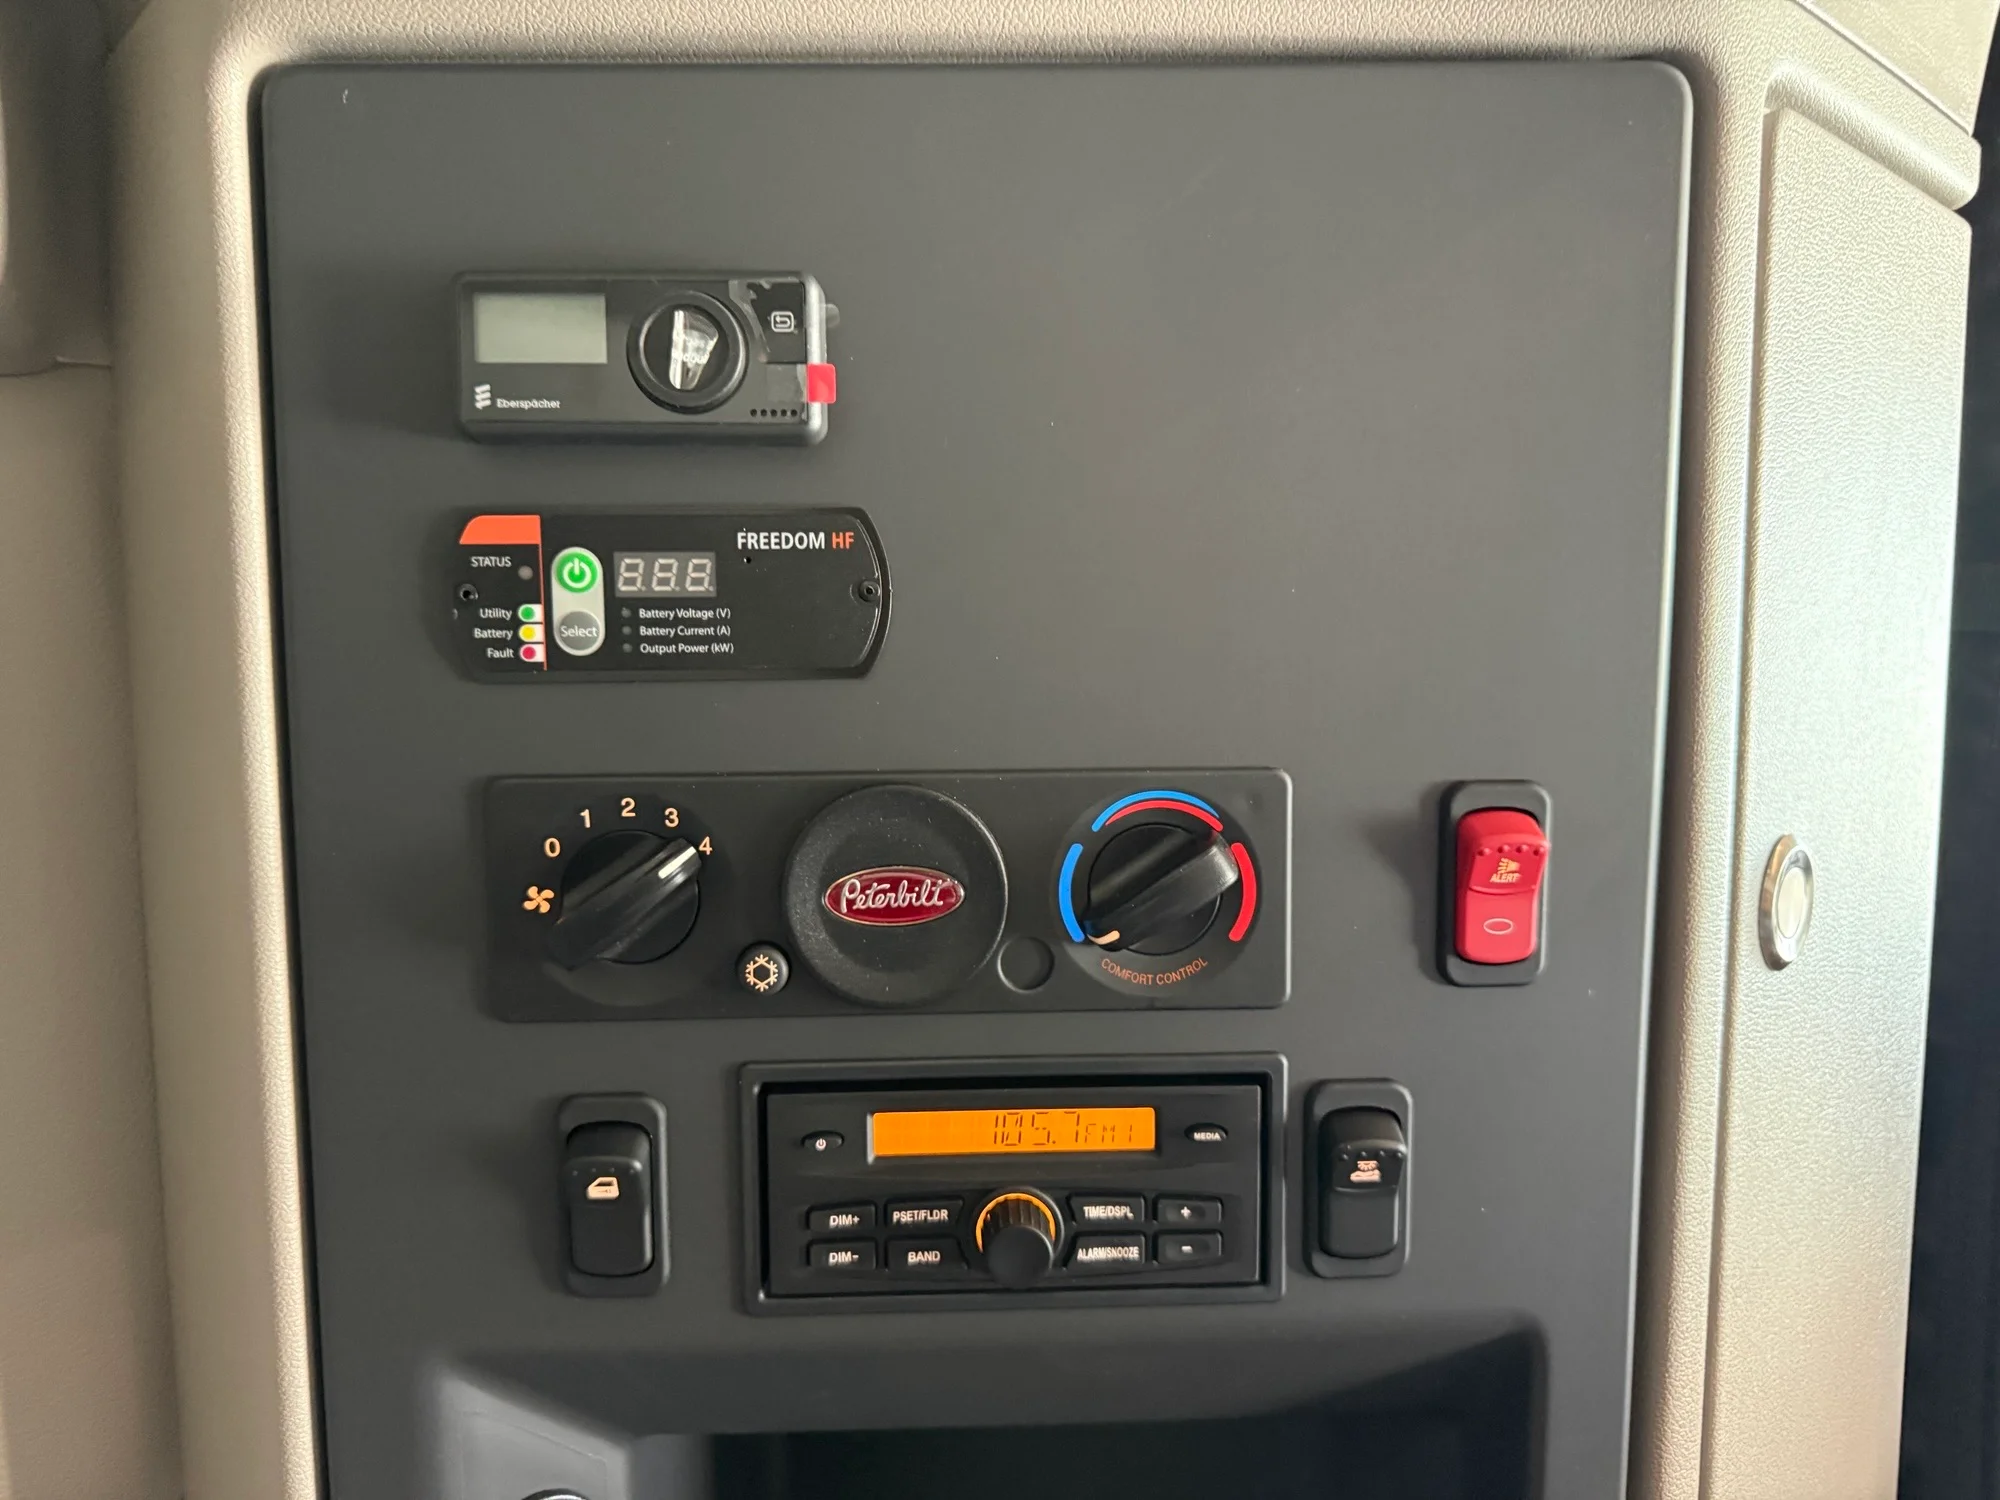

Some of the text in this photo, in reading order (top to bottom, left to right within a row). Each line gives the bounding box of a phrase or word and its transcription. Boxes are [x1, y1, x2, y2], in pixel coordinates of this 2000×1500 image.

[737, 532, 855, 550] FREEDOM HF
[471, 556, 511, 568] STATUS
[480, 607, 512, 620] Utility
[639, 608, 730, 621] Battery Voltage (V)
[474, 628, 513, 640] Battery
[560, 624, 598, 638] Select
[639, 625, 730, 638] Battery Current (A)
[487, 647, 514, 658] Fault
[639, 642, 734, 655] Output Power (kW)
[620, 798, 636, 817] 2
[579, 809, 592, 828] 1
[665, 807, 680, 827] 3
[544, 838, 561, 858] 0
[699, 836, 713, 855] 4
[1490, 873, 1521, 883] ALERT
[840, 878, 948, 912] Peterbilt
[1101, 957, 1209, 985] COMFORT CONTROL
[1194, 1132, 1220, 1140] MEDIA
[892, 1208, 949, 1223] PSET/FLDR
[1083, 1205, 1134, 1218] TIME/DSPL
[829, 1214, 860, 1226] DIM+
[908, 1250, 940, 1262] BAND
